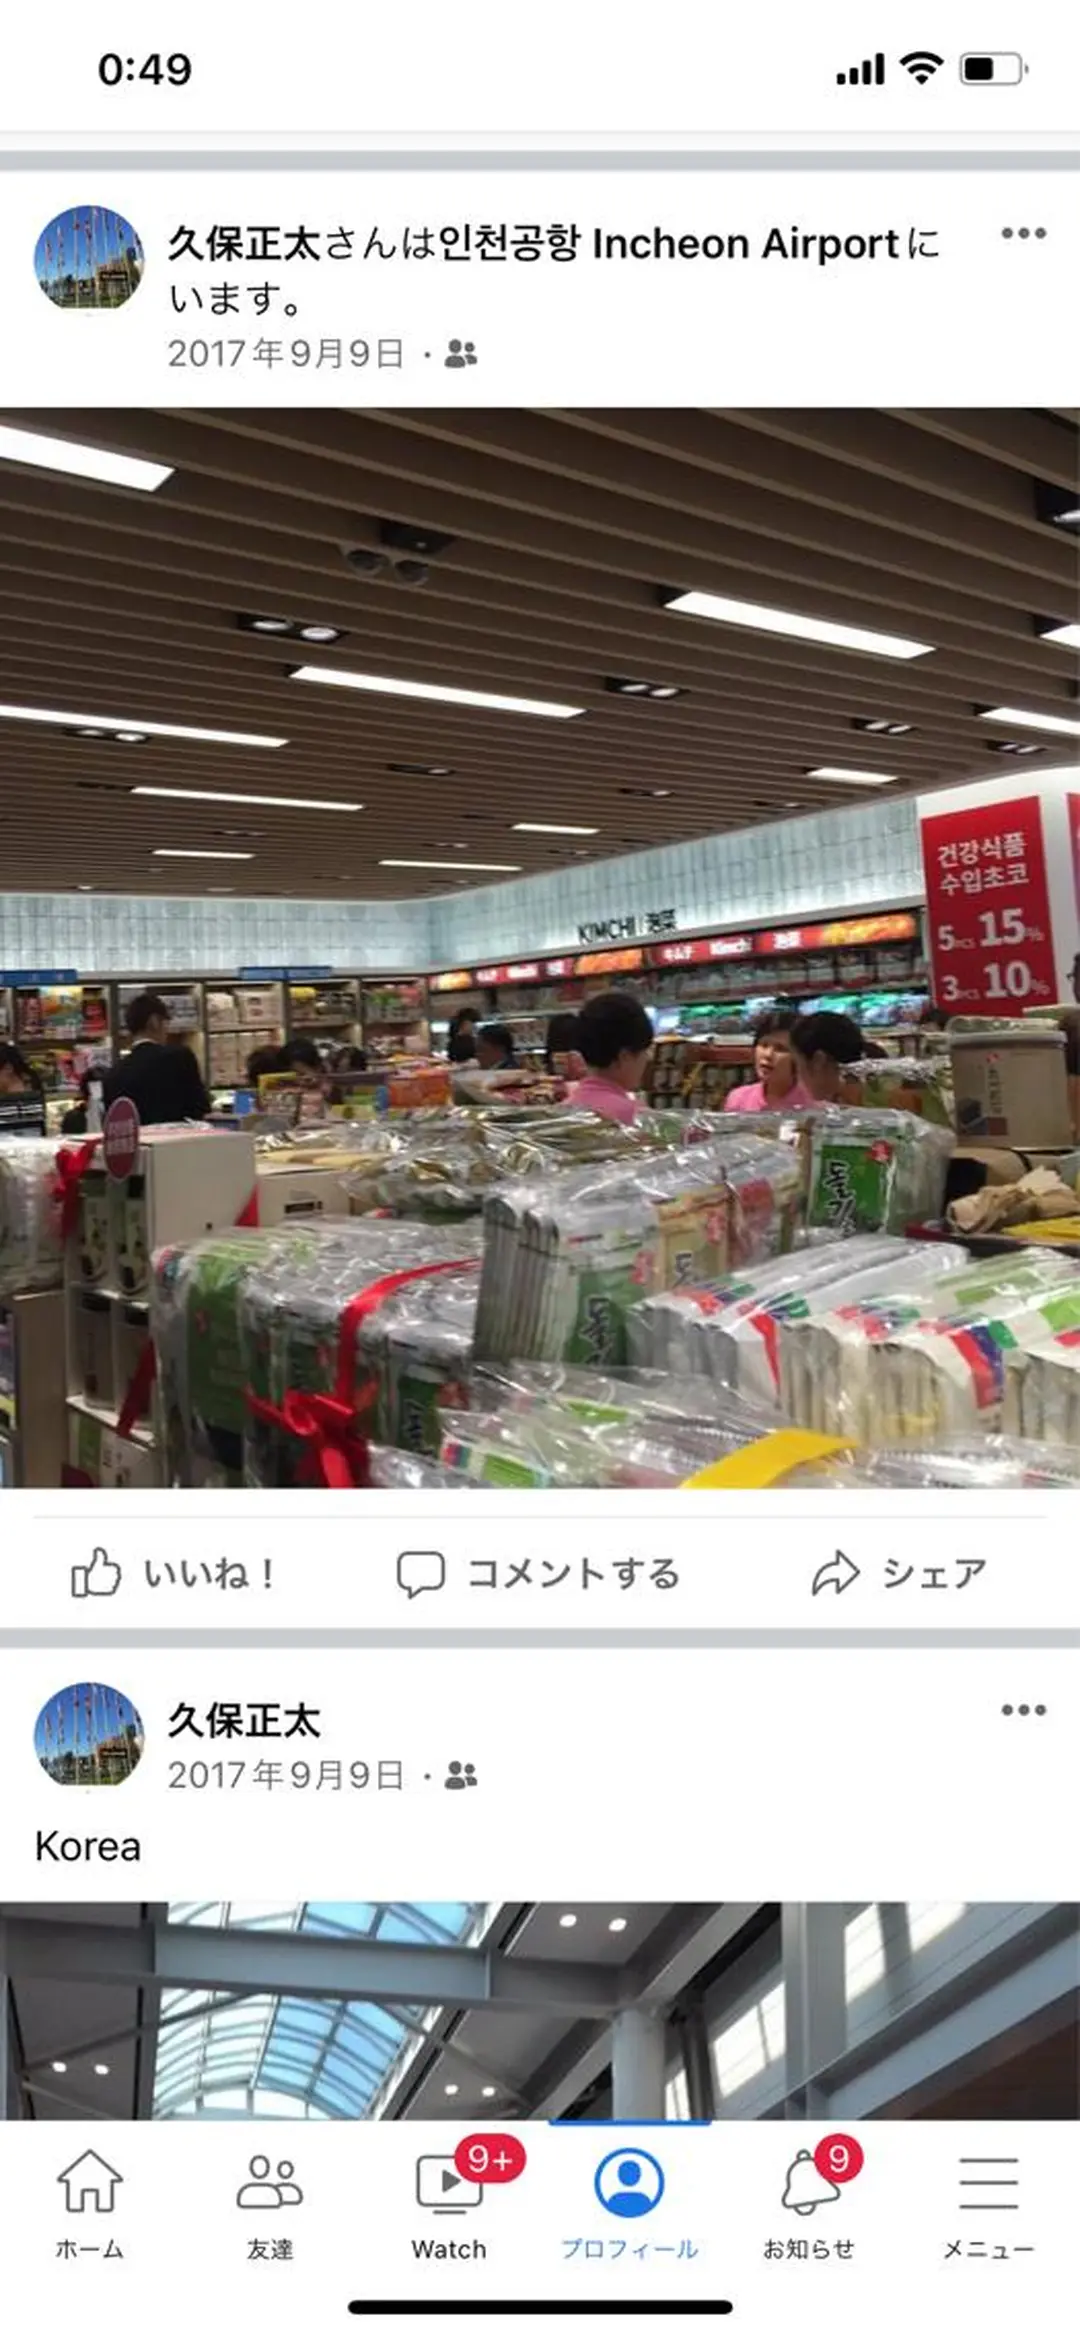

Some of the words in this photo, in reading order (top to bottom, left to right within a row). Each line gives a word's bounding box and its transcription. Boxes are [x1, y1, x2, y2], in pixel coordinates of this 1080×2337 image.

[98, 53, 191, 86] 0:49
[593, 228, 751, 261] Incheon
[171, 281, 298, 318] います。
[168, 337, 402, 369] 2017年9月9日
[937, 831, 1027, 869] 건강식품
[939, 862, 1030, 896] 수입초코
[578, 915, 636, 944] KIMCHI
[144, 1556, 272, 1591] いいね！
[469, 1556, 679, 1591] コメントする
[884, 1558, 987, 1590] シェア
[168, 1702, 322, 1740] 久保正太
[168, 1758, 402, 1791] 2017年9月9日
[36, 1830, 141, 1863] Korea
[468, 2144, 513, 2174] 9+
[829, 2144, 850, 2174] 9
[56, 2238, 124, 2260] ホーム
[247, 2237, 294, 2261] 友達
[411, 2238, 487, 2260] Watch
[563, 2237, 699, 2260] プロフィール
[763, 2237, 855, 2260] お知らせ
[944, 2239, 1035, 2260] メニュー
